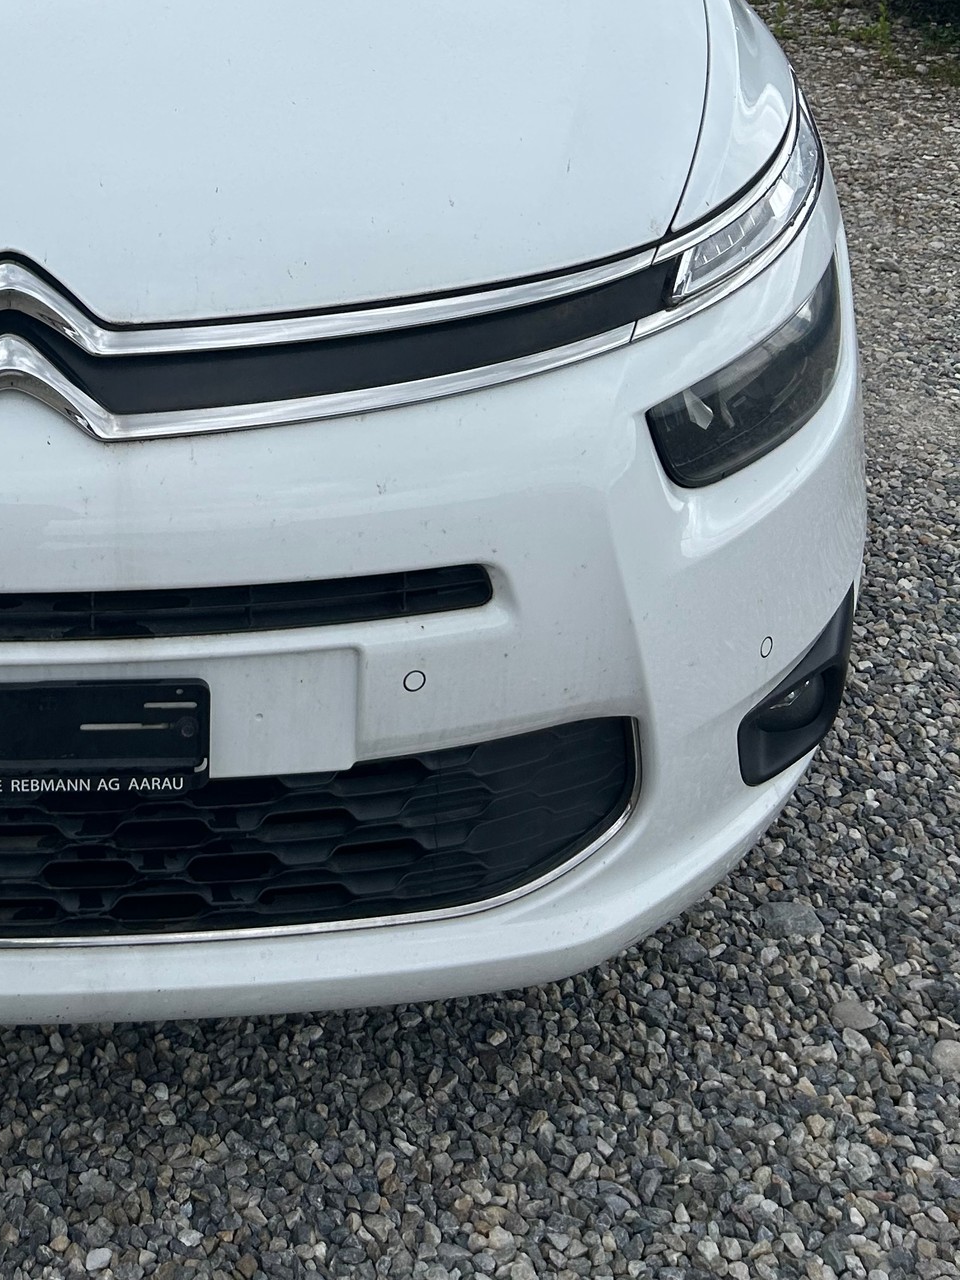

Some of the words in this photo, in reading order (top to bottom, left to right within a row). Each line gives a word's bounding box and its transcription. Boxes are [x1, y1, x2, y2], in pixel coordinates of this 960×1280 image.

[11, 778, 91, 792] REBMANN
[96, 777, 120, 791] AG
[128, 777, 184, 790] AARAU
